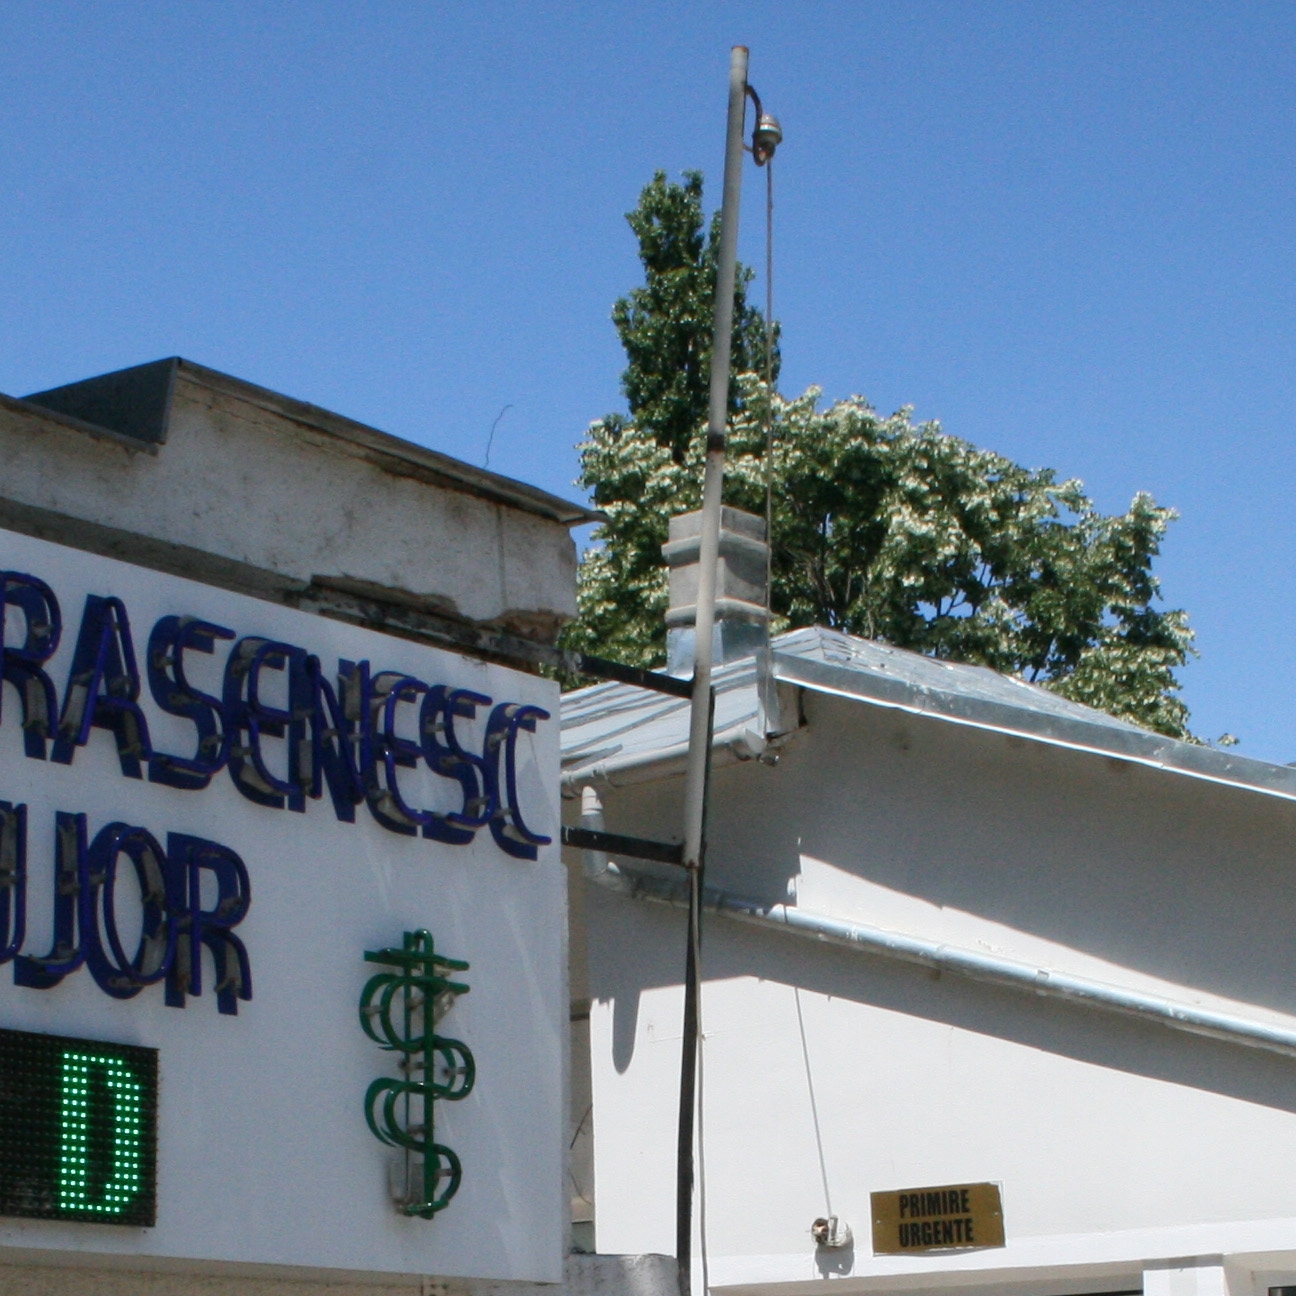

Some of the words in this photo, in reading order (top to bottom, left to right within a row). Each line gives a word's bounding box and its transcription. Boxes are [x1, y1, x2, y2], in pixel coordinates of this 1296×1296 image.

[59, 1052, 142, 1214] D
[899, 1189, 971, 1218] PRIMIRE
[898, 1218, 974, 1247] URGENTE
